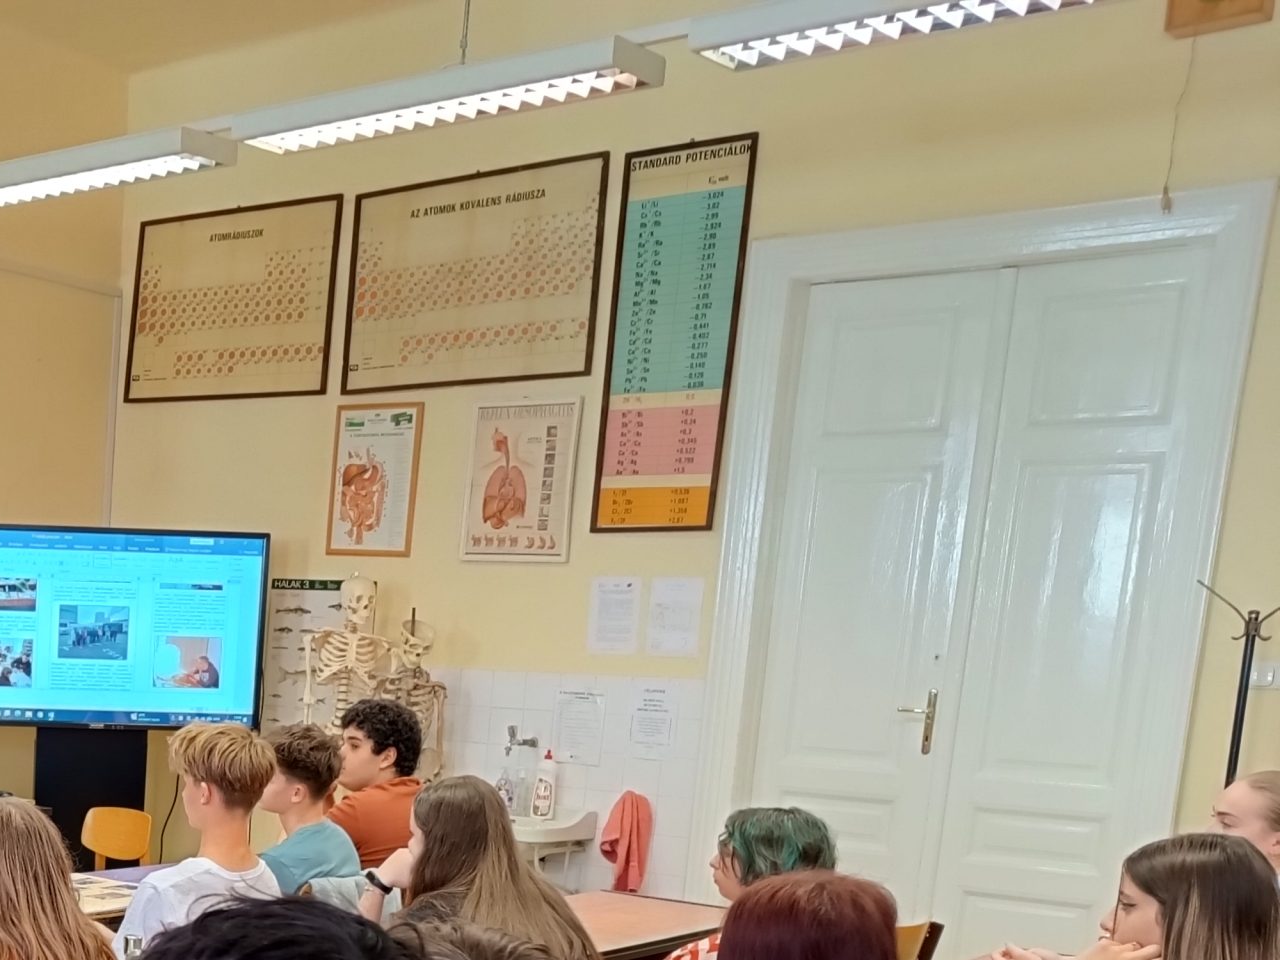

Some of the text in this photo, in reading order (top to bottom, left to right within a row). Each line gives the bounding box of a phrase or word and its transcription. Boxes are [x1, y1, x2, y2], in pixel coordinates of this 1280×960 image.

[631, 155, 681, 172] STANDARD
[410, 188, 546, 219] AZ ATOMOK KOVALENS RÁDIUSZA
[209, 228, 264, 242] ATOMRÁDIUSZOK
[274, 580, 310, 589] HALAK 3
